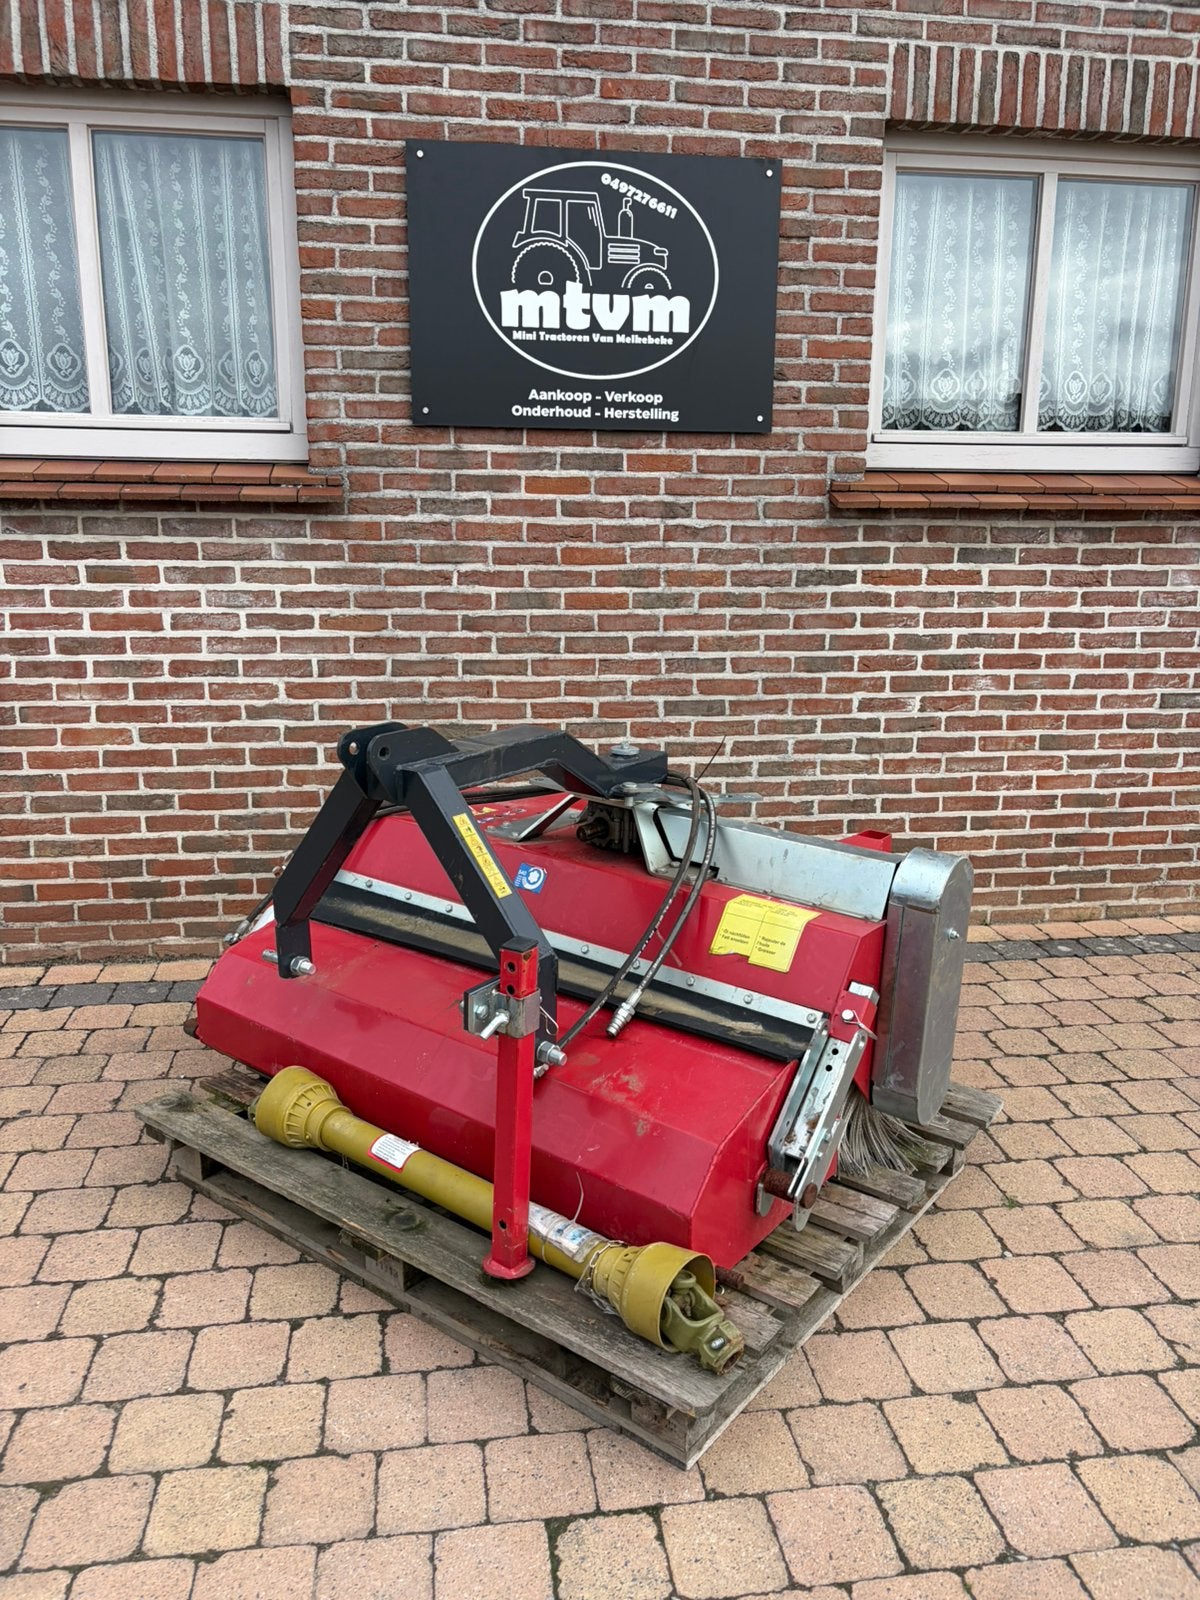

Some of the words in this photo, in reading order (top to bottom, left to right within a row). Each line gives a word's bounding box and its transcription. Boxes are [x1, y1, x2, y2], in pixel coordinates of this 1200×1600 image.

[601, 173, 677, 219] 0497276611
[500, 280, 691, 333] mtvm
[512, 330, 537, 341] Mini
[538, 331, 591, 343] Tractoren
[592, 332, 614, 344] Van
[615, 333, 674, 346] Melkebeke
[528, 388, 593, 404] Aankoop
[604, 390, 664, 406] Verkoop
[511, 404, 592, 418] Onderhoud
[604, 407, 680, 423] Herstelling
